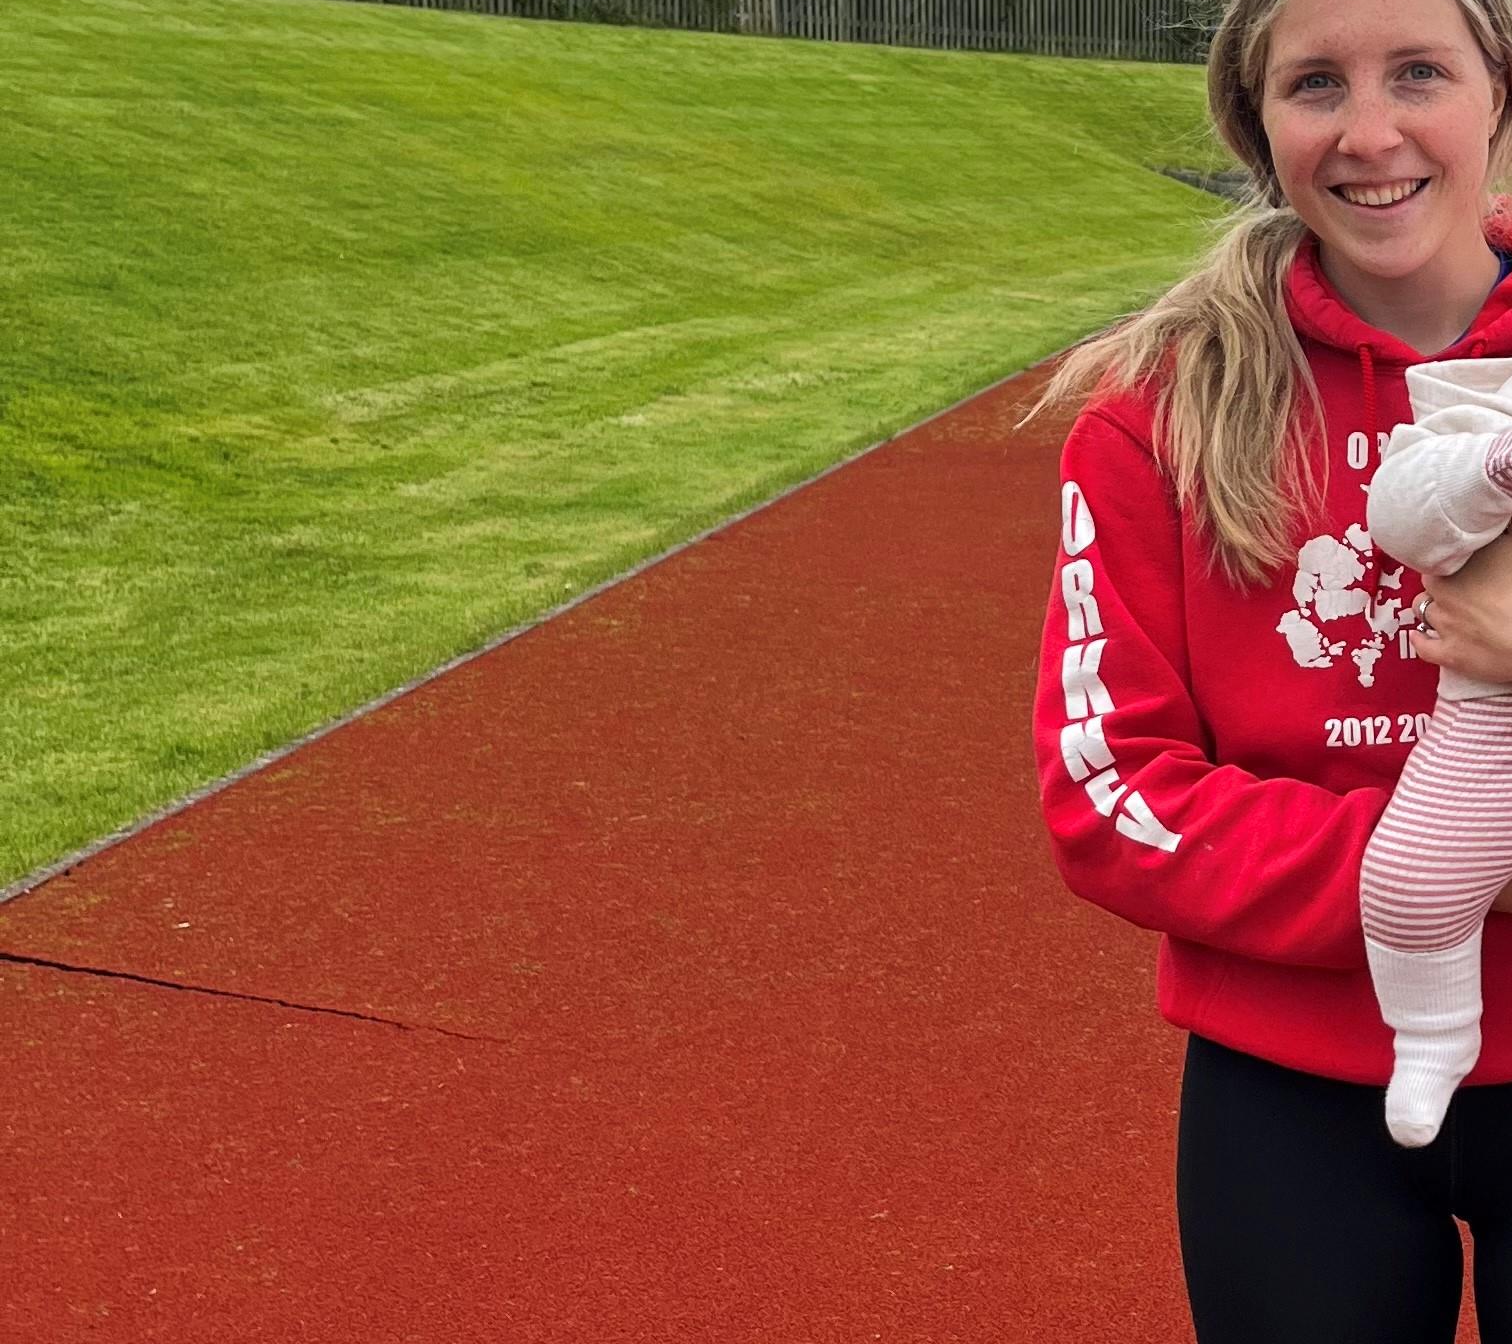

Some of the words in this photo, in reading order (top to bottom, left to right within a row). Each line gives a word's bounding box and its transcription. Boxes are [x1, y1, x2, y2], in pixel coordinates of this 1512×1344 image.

[1061, 480, 1182, 853] ORKNEY
[1324, 716, 1393, 747] 2012
[1397, 713, 1432, 743] 20
